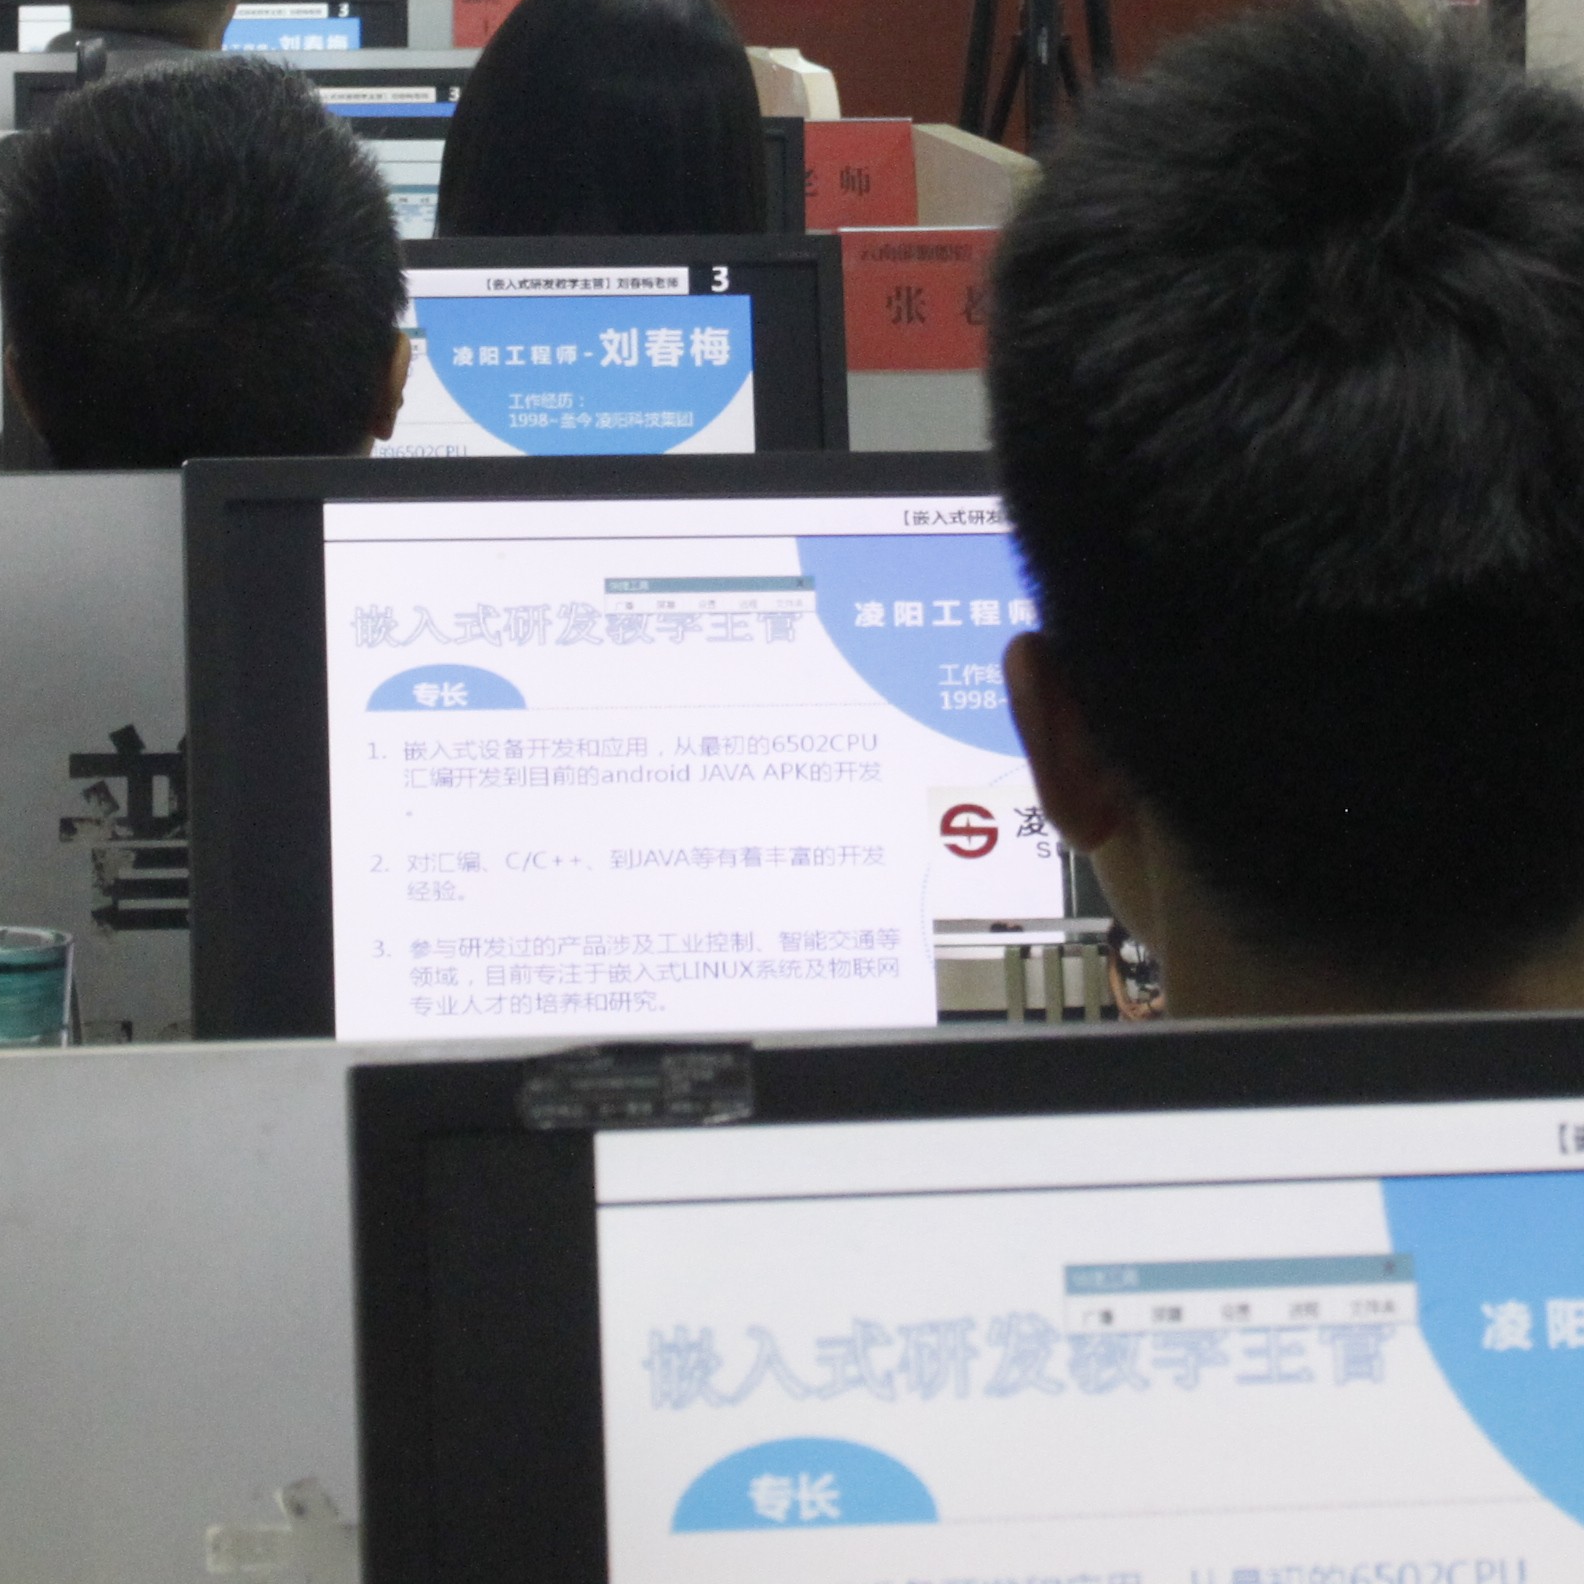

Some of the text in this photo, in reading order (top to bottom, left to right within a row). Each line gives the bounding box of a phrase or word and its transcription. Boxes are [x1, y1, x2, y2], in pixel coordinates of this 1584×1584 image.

[448, 86, 461, 102] 3
[711, 266, 730, 292] 3
[452, 326, 731, 368] 凌阳工程师-刘春梅
[411, 680, 469, 708] 专长
[699, 761, 757, 786] JAVA
[763, 757, 883, 786] APK的开发
[748, 1472, 841, 1524] 专长
